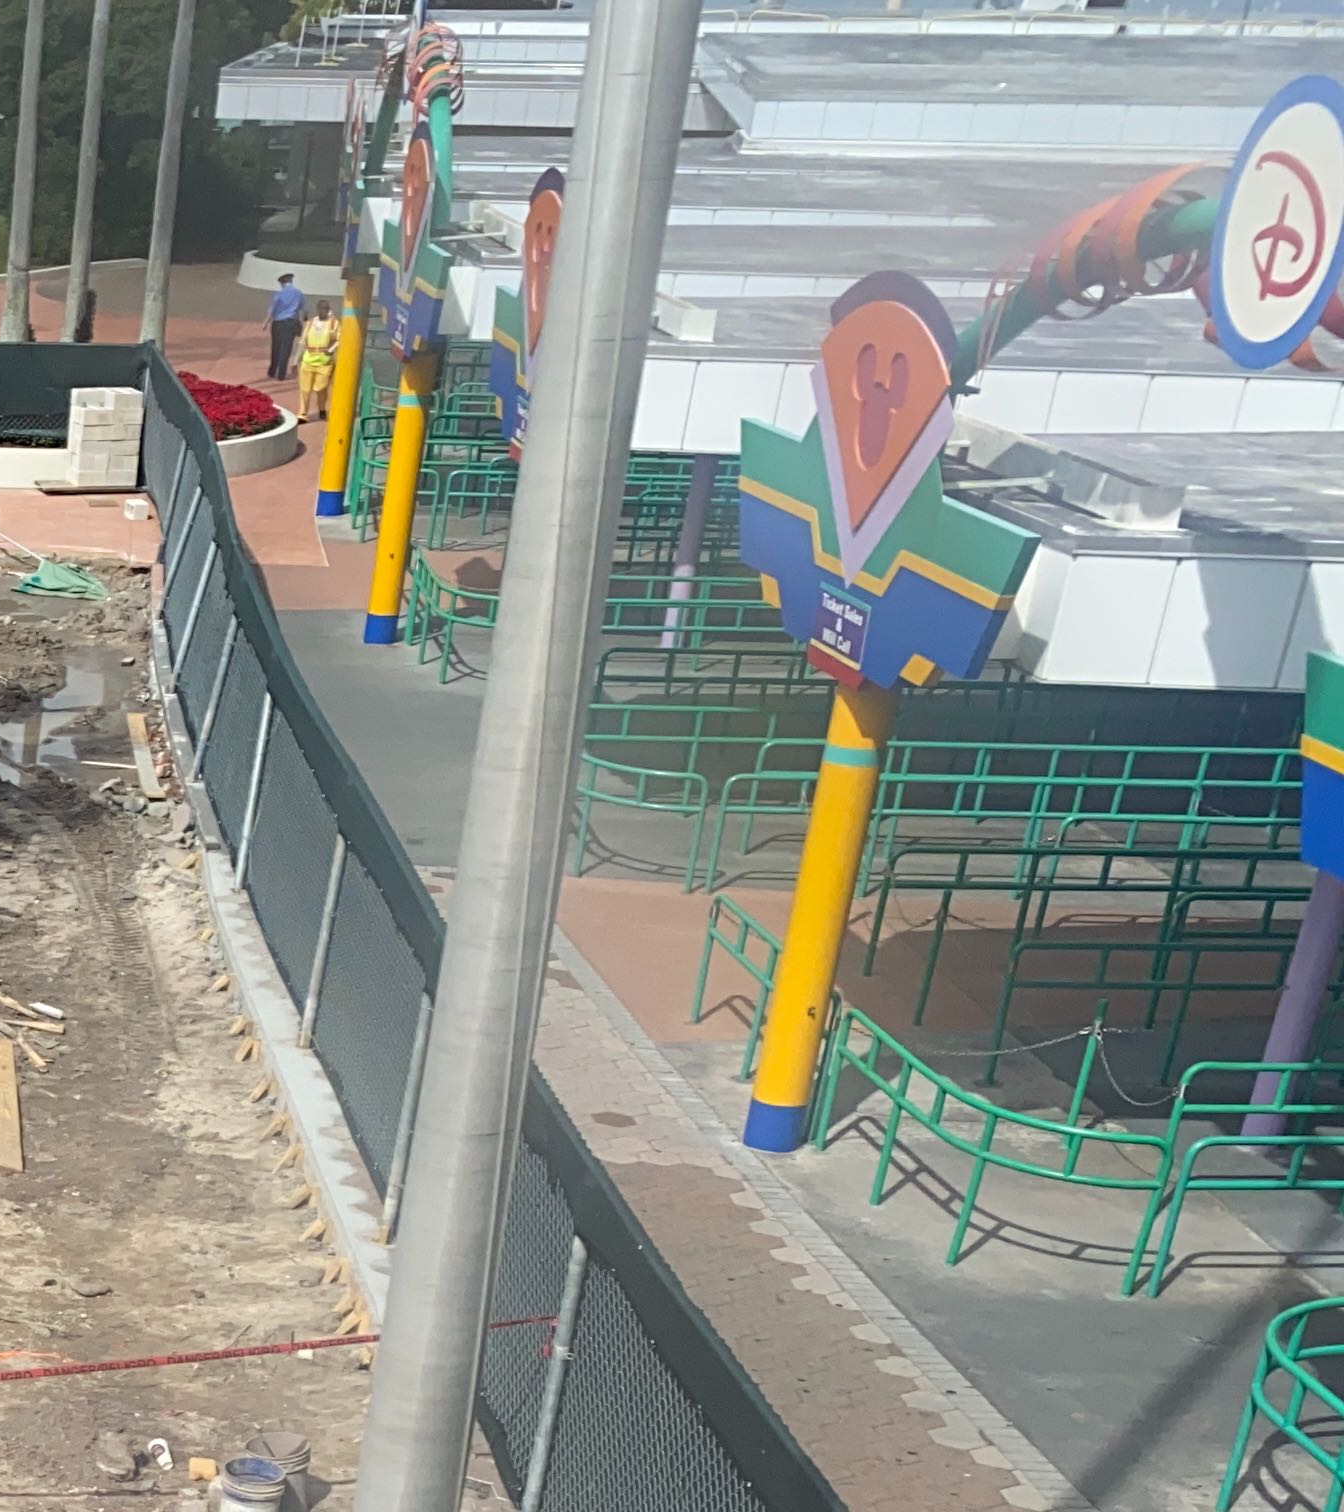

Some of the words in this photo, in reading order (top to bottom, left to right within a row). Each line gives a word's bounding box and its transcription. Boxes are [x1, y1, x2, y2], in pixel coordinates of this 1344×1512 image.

[1252, 150, 1326, 301] D
[822, 592, 844, 617] Ticket
[844, 605, 863, 627] Sales
[837, 635, 852, 655] Call
